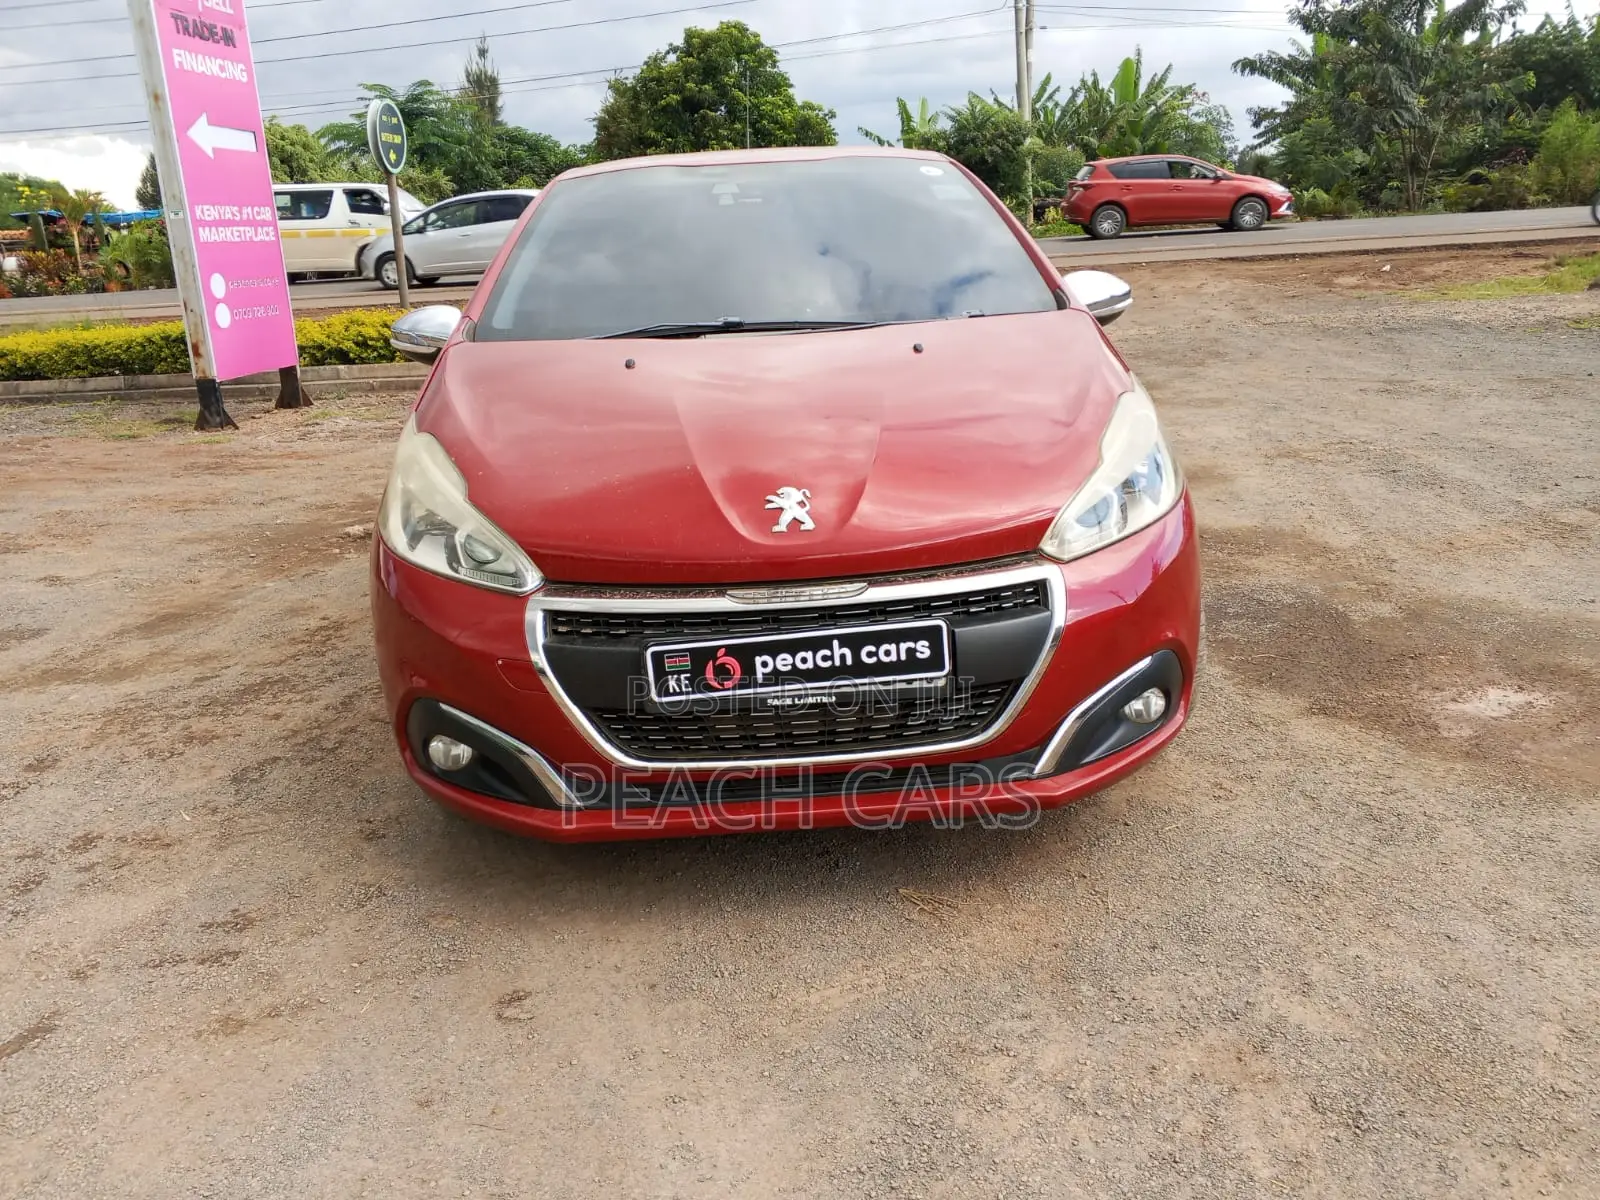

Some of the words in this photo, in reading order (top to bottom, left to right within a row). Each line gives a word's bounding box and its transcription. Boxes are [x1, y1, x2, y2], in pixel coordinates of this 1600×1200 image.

[170, 12, 237, 48] TRADE-IN
[172, 48, 248, 83] FINANCING
[195, 204, 241, 221] KENYA'S
[242, 205, 253, 221] #1
[253, 206, 273, 221] CAR
[198, 226, 276, 243] MARKETPLACE
[754, 640, 852, 684] peach
[859, 639, 932, 665] cars
[668, 673, 692, 693] KE
